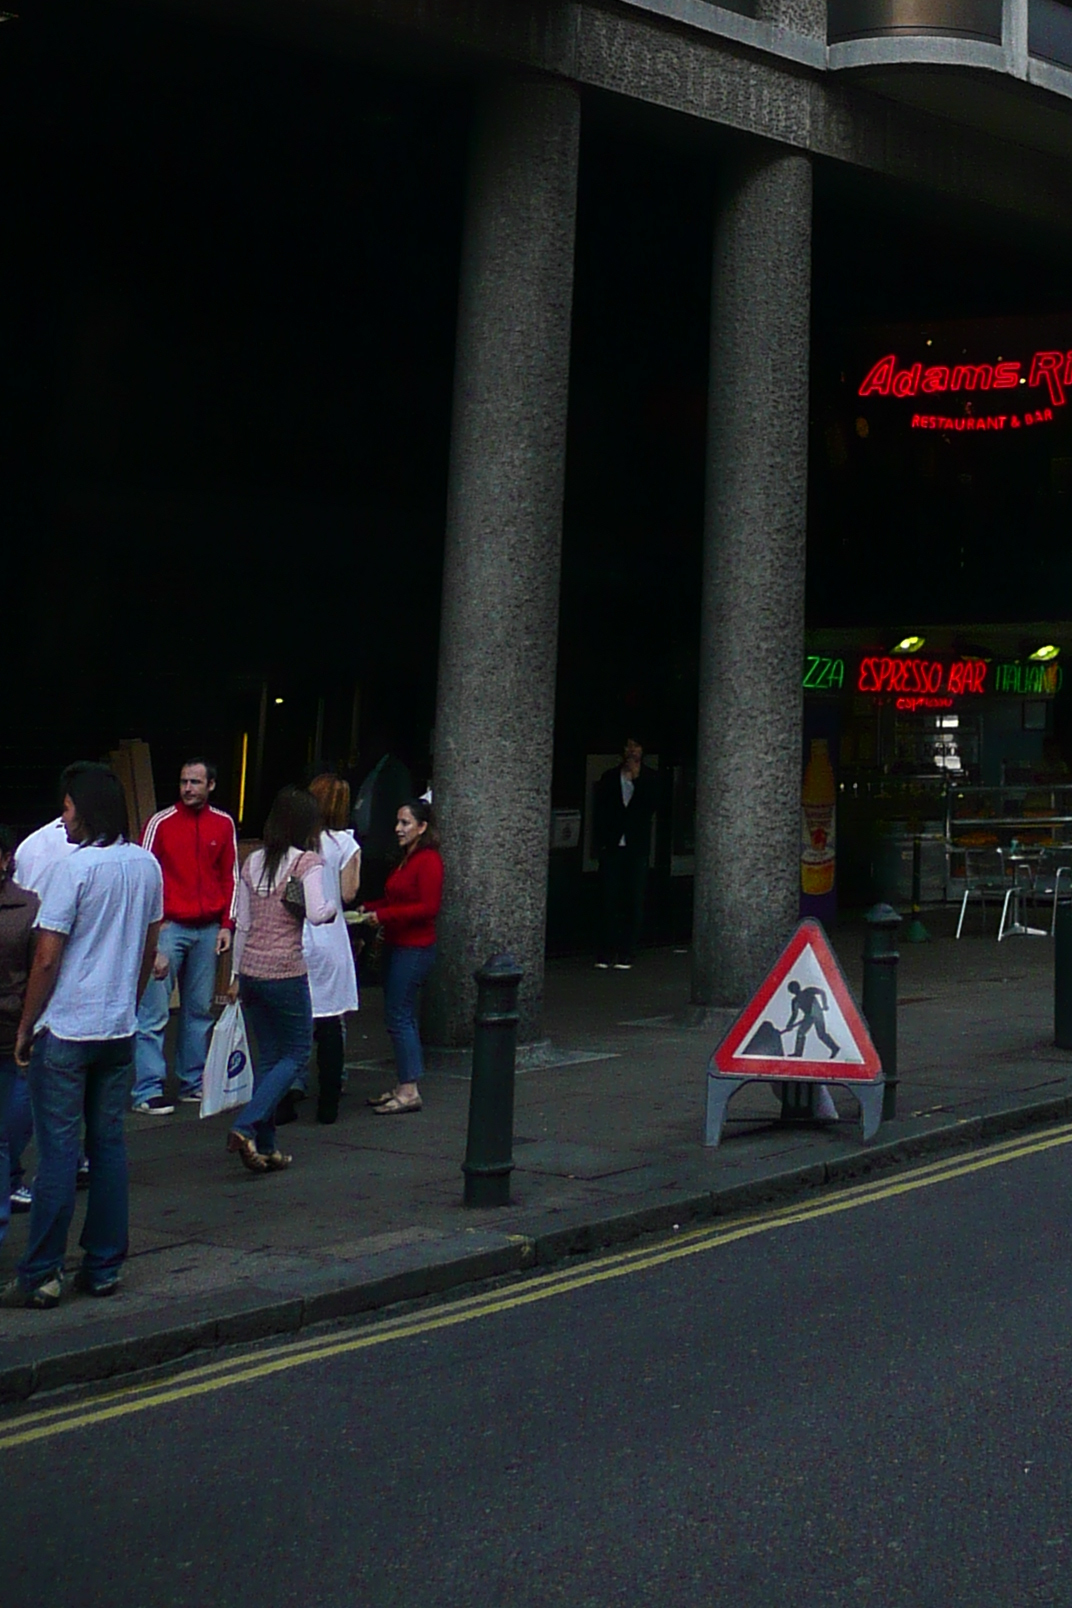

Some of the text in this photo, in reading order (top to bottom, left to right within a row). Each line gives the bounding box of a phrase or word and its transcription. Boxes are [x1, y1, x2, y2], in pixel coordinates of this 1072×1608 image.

[858, 354, 1021, 398] Adams
[911, 408, 1053, 431] RESTAURANT & BAR
[802, 655, 845, 690] ZZA
[858, 656, 988, 694] ESPRESSO BAR
